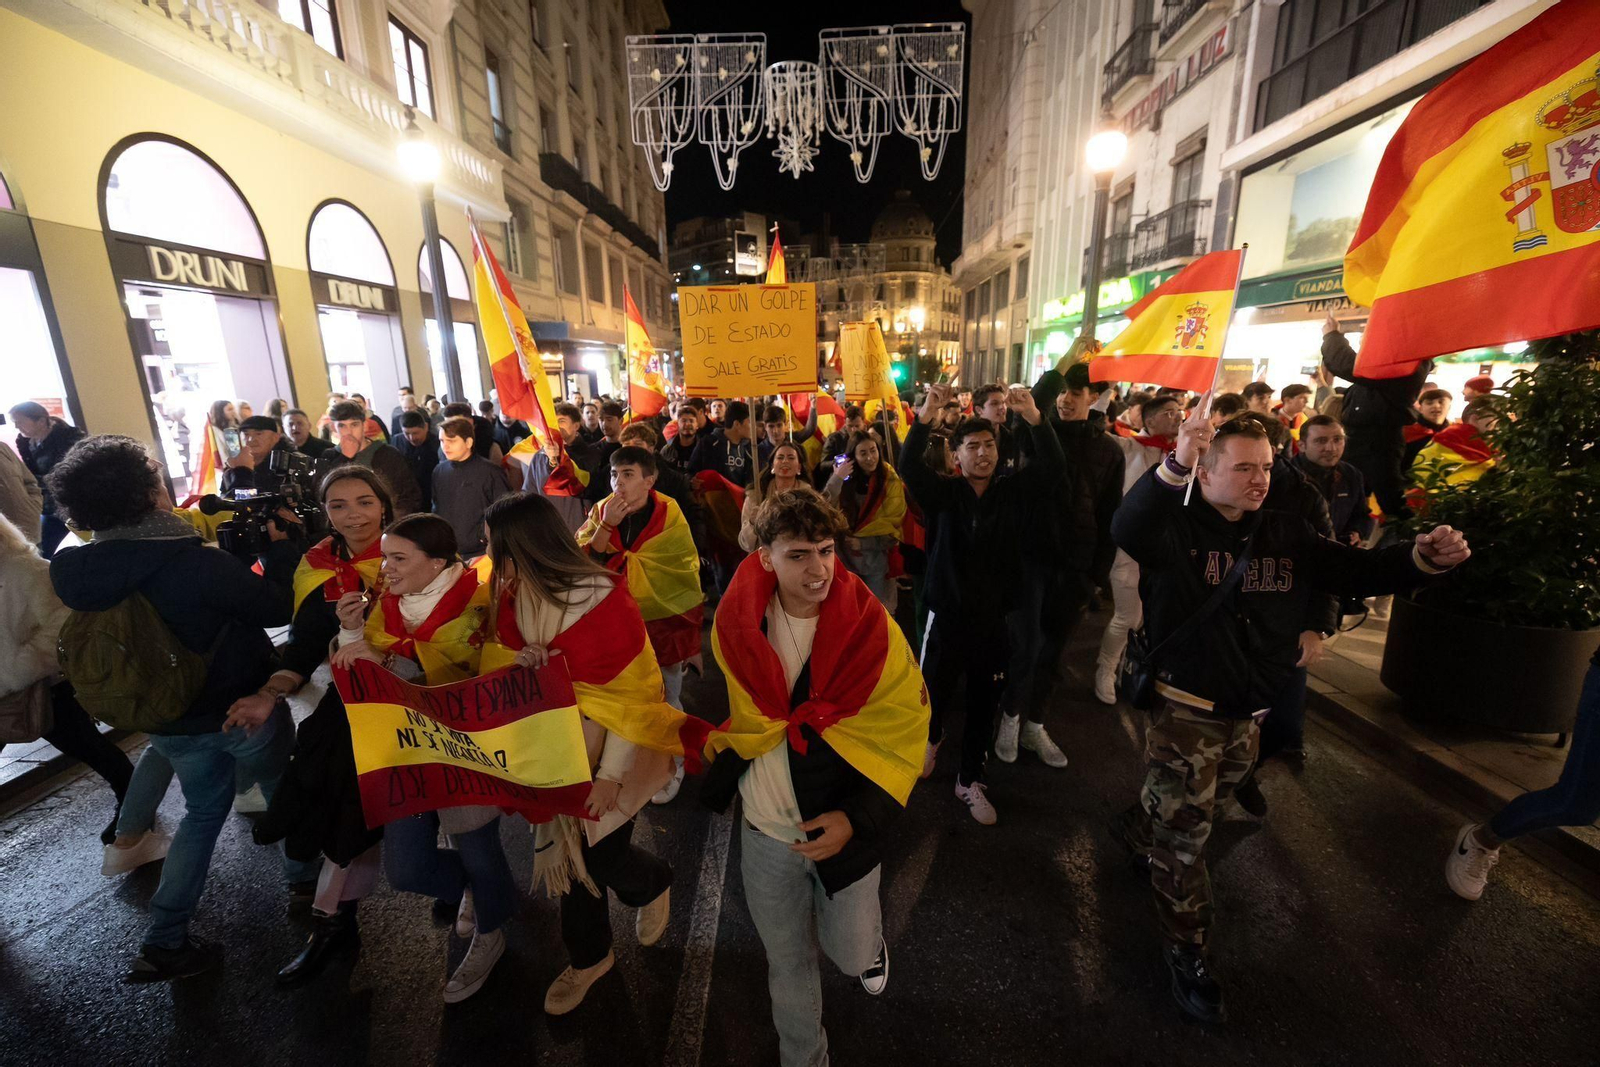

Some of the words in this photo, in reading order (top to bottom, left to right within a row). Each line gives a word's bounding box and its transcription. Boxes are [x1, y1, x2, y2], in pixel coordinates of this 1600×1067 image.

[147, 245, 249, 291] DRUNI
[327, 279, 385, 310] DRUNI
[1300, 278, 1344, 294] VIANDA
[684, 292, 722, 316] DAR
[729, 292, 749, 312] UN
[760, 289, 807, 310] GOLPE
[692, 325, 717, 346] DE
[728, 322, 791, 343] ESTADO
[703, 356, 742, 378] SALE
[1191, 549, 1292, 592] AERS
[475, 666, 543, 721] ESPAÑA
[404, 708, 427, 728] NO
[396, 727, 421, 749] NI
